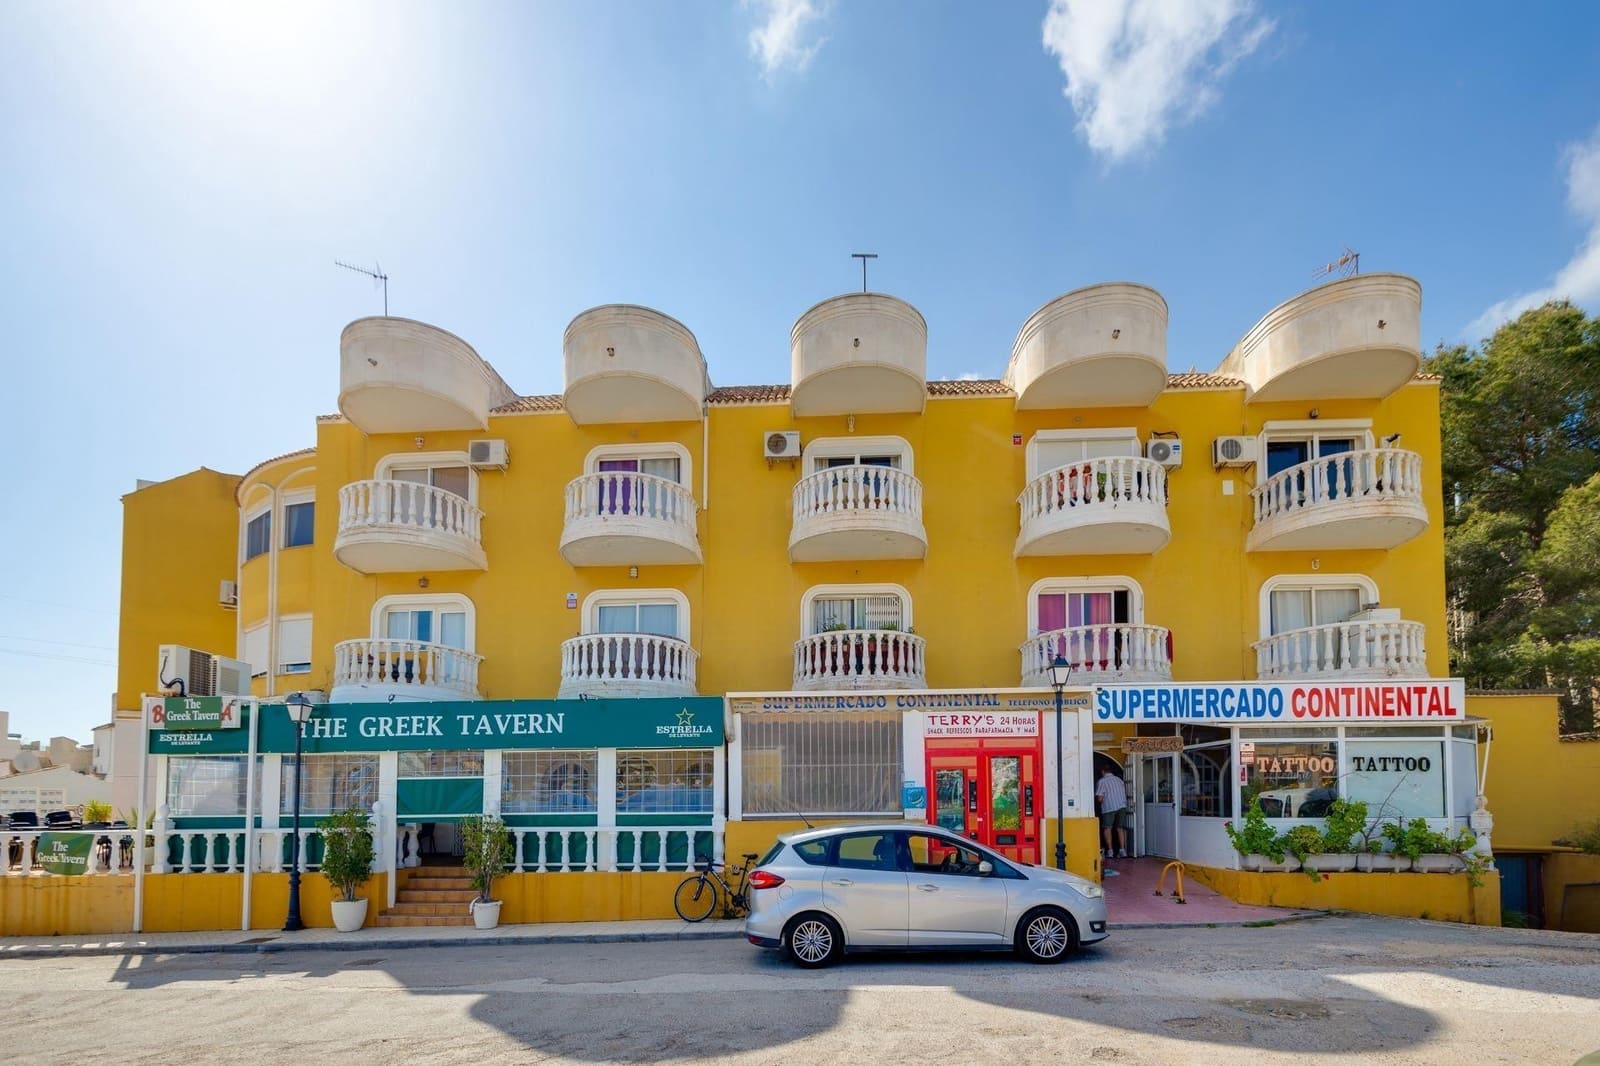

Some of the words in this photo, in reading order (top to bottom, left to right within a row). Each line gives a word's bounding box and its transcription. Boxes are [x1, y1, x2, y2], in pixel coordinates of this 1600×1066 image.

[184, 698, 202, 709] The
[763, 695, 887, 710] SUPERMERCADO
[895, 693, 1000, 708] CONTINENTAL
[1097, 689, 1283, 720] SUPERMERCADO
[1291, 686, 1457, 719] CONTINENTAL
[166, 710, 191, 721] Greek
[192, 711, 220, 721] Tavern
[927, 714, 995, 727] TERRY'S
[1000, 716, 1010, 725] 24
[296, 717, 348, 738] THE
[359, 715, 443, 738] GREEK
[457, 712, 565, 736] TAVERN
[656, 724, 713, 734] ESTRELLA
[159, 733, 213, 742] ESTRELLA
[1256, 756, 1335, 773] TATTOO
[1353, 756, 1431, 773] TATTOO
[52, 841, 69, 852] The
[37, 851, 59, 863] Greek
